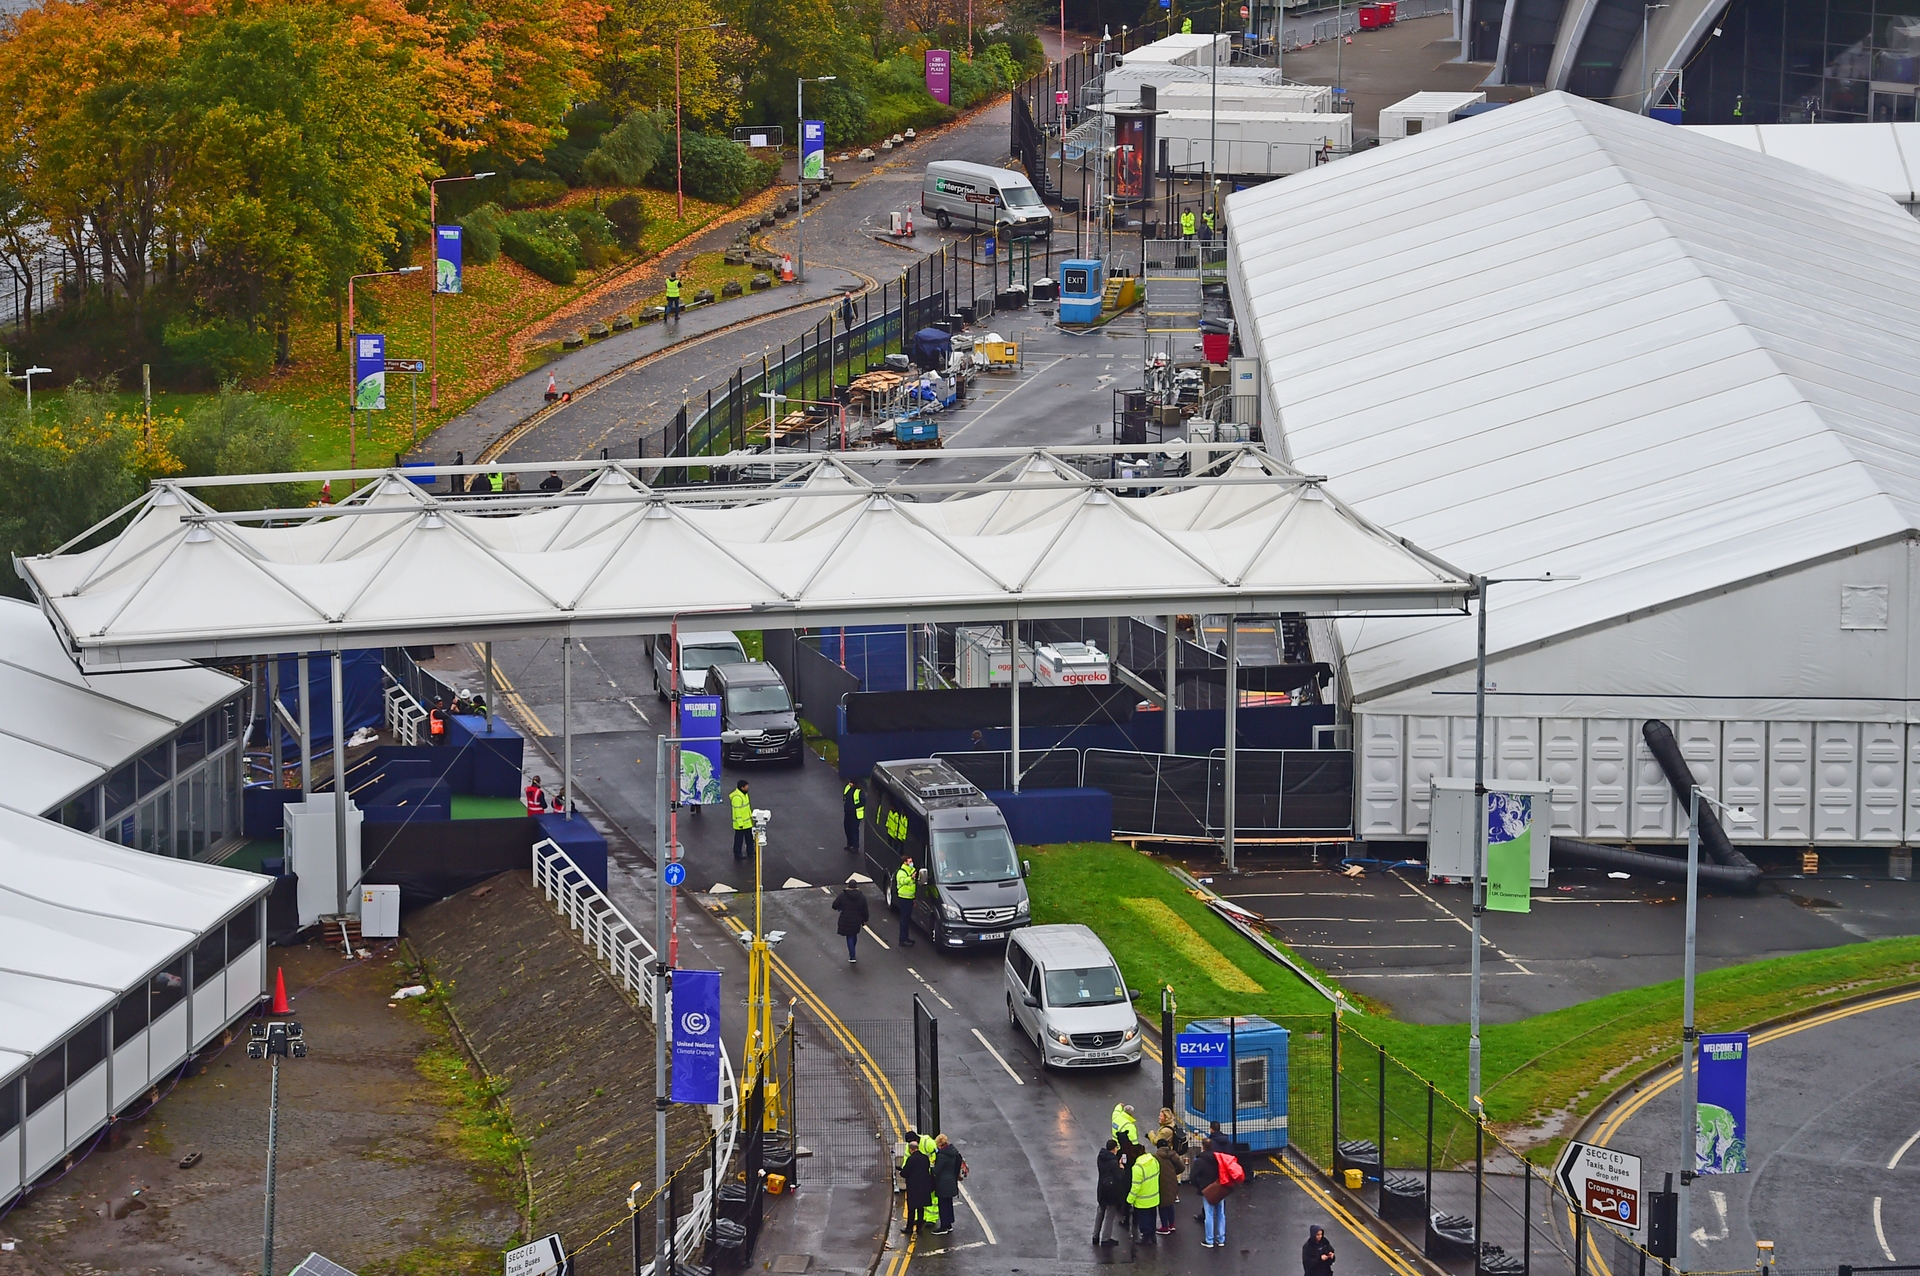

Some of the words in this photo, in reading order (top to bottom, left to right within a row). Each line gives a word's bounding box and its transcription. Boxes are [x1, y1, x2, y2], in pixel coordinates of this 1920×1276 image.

[938, 181, 976, 194] enterprise
[1067, 276, 1084, 284] EXIT
[1062, 671, 1107, 685] aggreko
[684, 703, 709, 711] WELCOME
[692, 709, 717, 717] GLASGOW
[696, 1049, 715, 1057] Change
[1180, 1042, 1225, 1053] BZ14-V
[1703, 1043, 1734, 1053] WELCOME
[1734, 1042, 1743, 1051] TO
[1712, 1051, 1742, 1060] GLASGOW
[1585, 1148, 1608, 1160] SECC
[1609, 1155, 1624, 1165] (E)
[1596, 1172, 1610, 1181] drop
[1608, 1165, 1630, 1177] Buses
[1587, 1181, 1615, 1195] Crowne
[1616, 1190, 1635, 1201] Plaza
[508, 1250, 525, 1263] SECC
[525, 1245, 537, 1256] (E)
[525, 1257, 541, 1268] Buses
